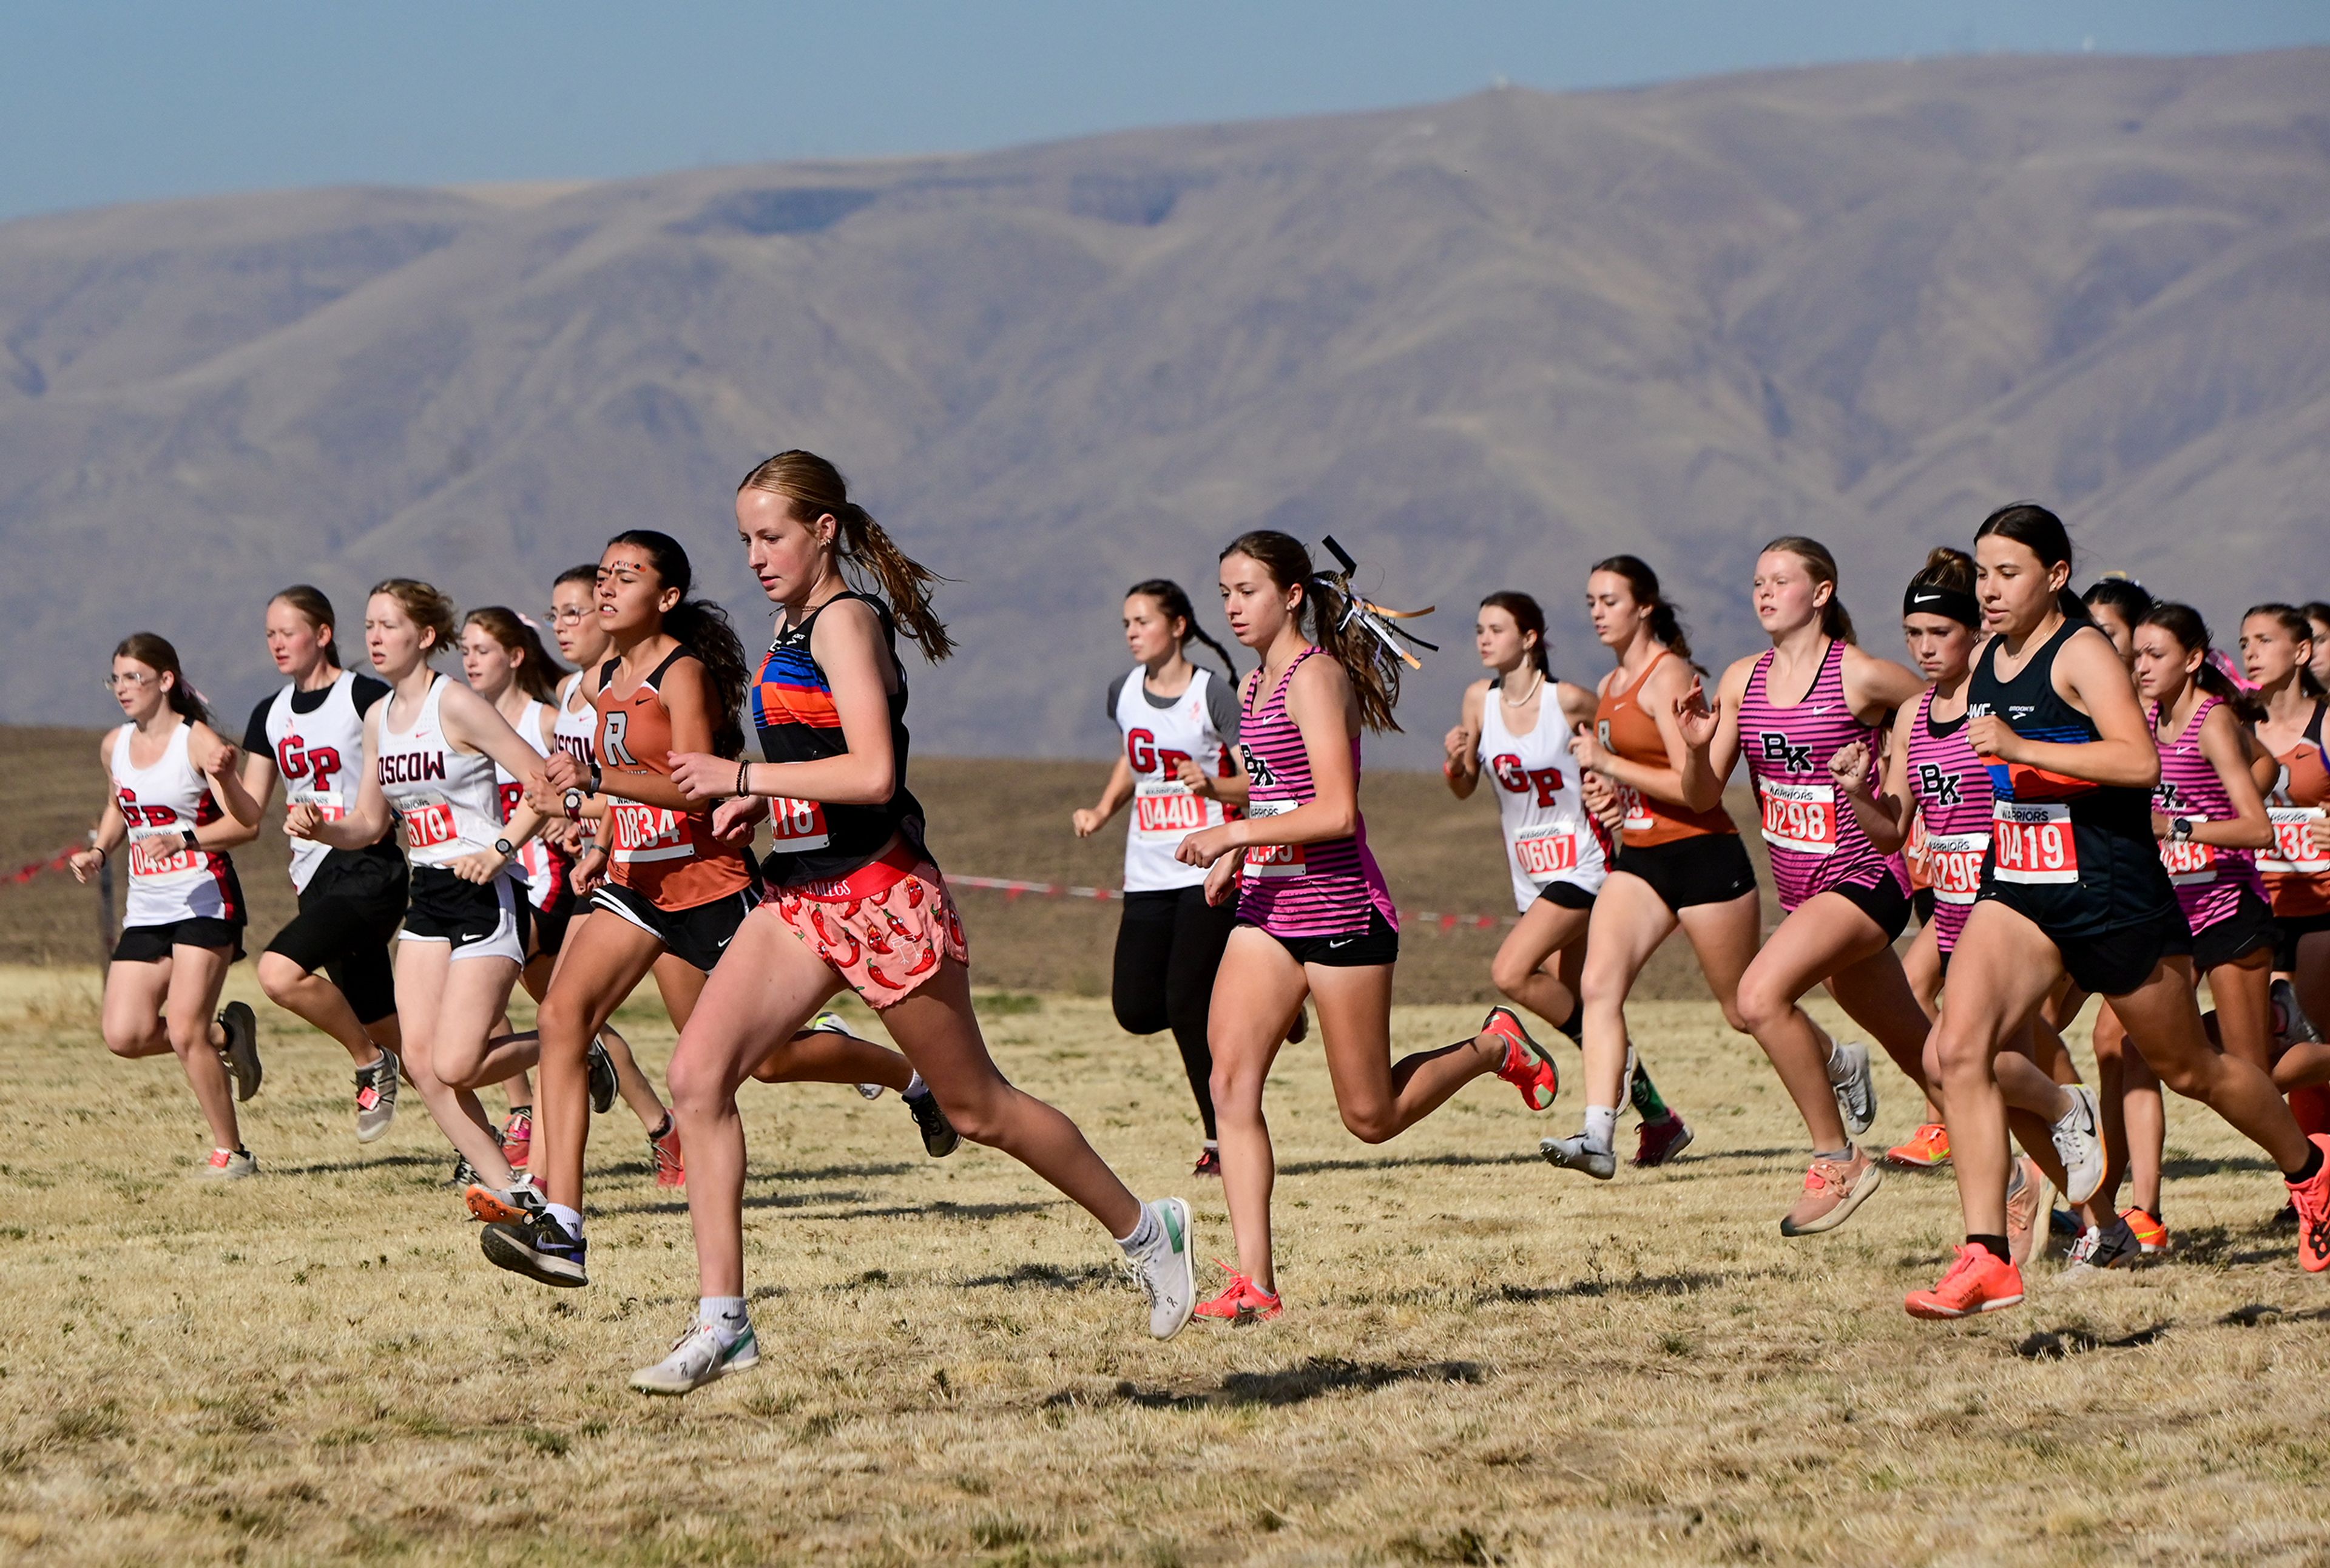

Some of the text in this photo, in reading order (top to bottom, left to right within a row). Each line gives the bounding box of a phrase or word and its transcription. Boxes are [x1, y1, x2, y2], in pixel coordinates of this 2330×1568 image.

[603, 711, 638, 766] R
[1760, 731, 1814, 774] BK
[278, 735, 342, 791] GP
[1493, 754, 1565, 808] GP
[1769, 786, 1814, 801] WARRIORS
[1918, 762, 1964, 808] BK
[615, 807, 680, 848] 0834
[1141, 796, 1198, 830] 0440
[1765, 796, 1826, 840] 0298
[2001, 811, 2049, 822] WARRIORS
[1517, 836, 1570, 873] 0607
[1999, 822, 2064, 869] 0419
